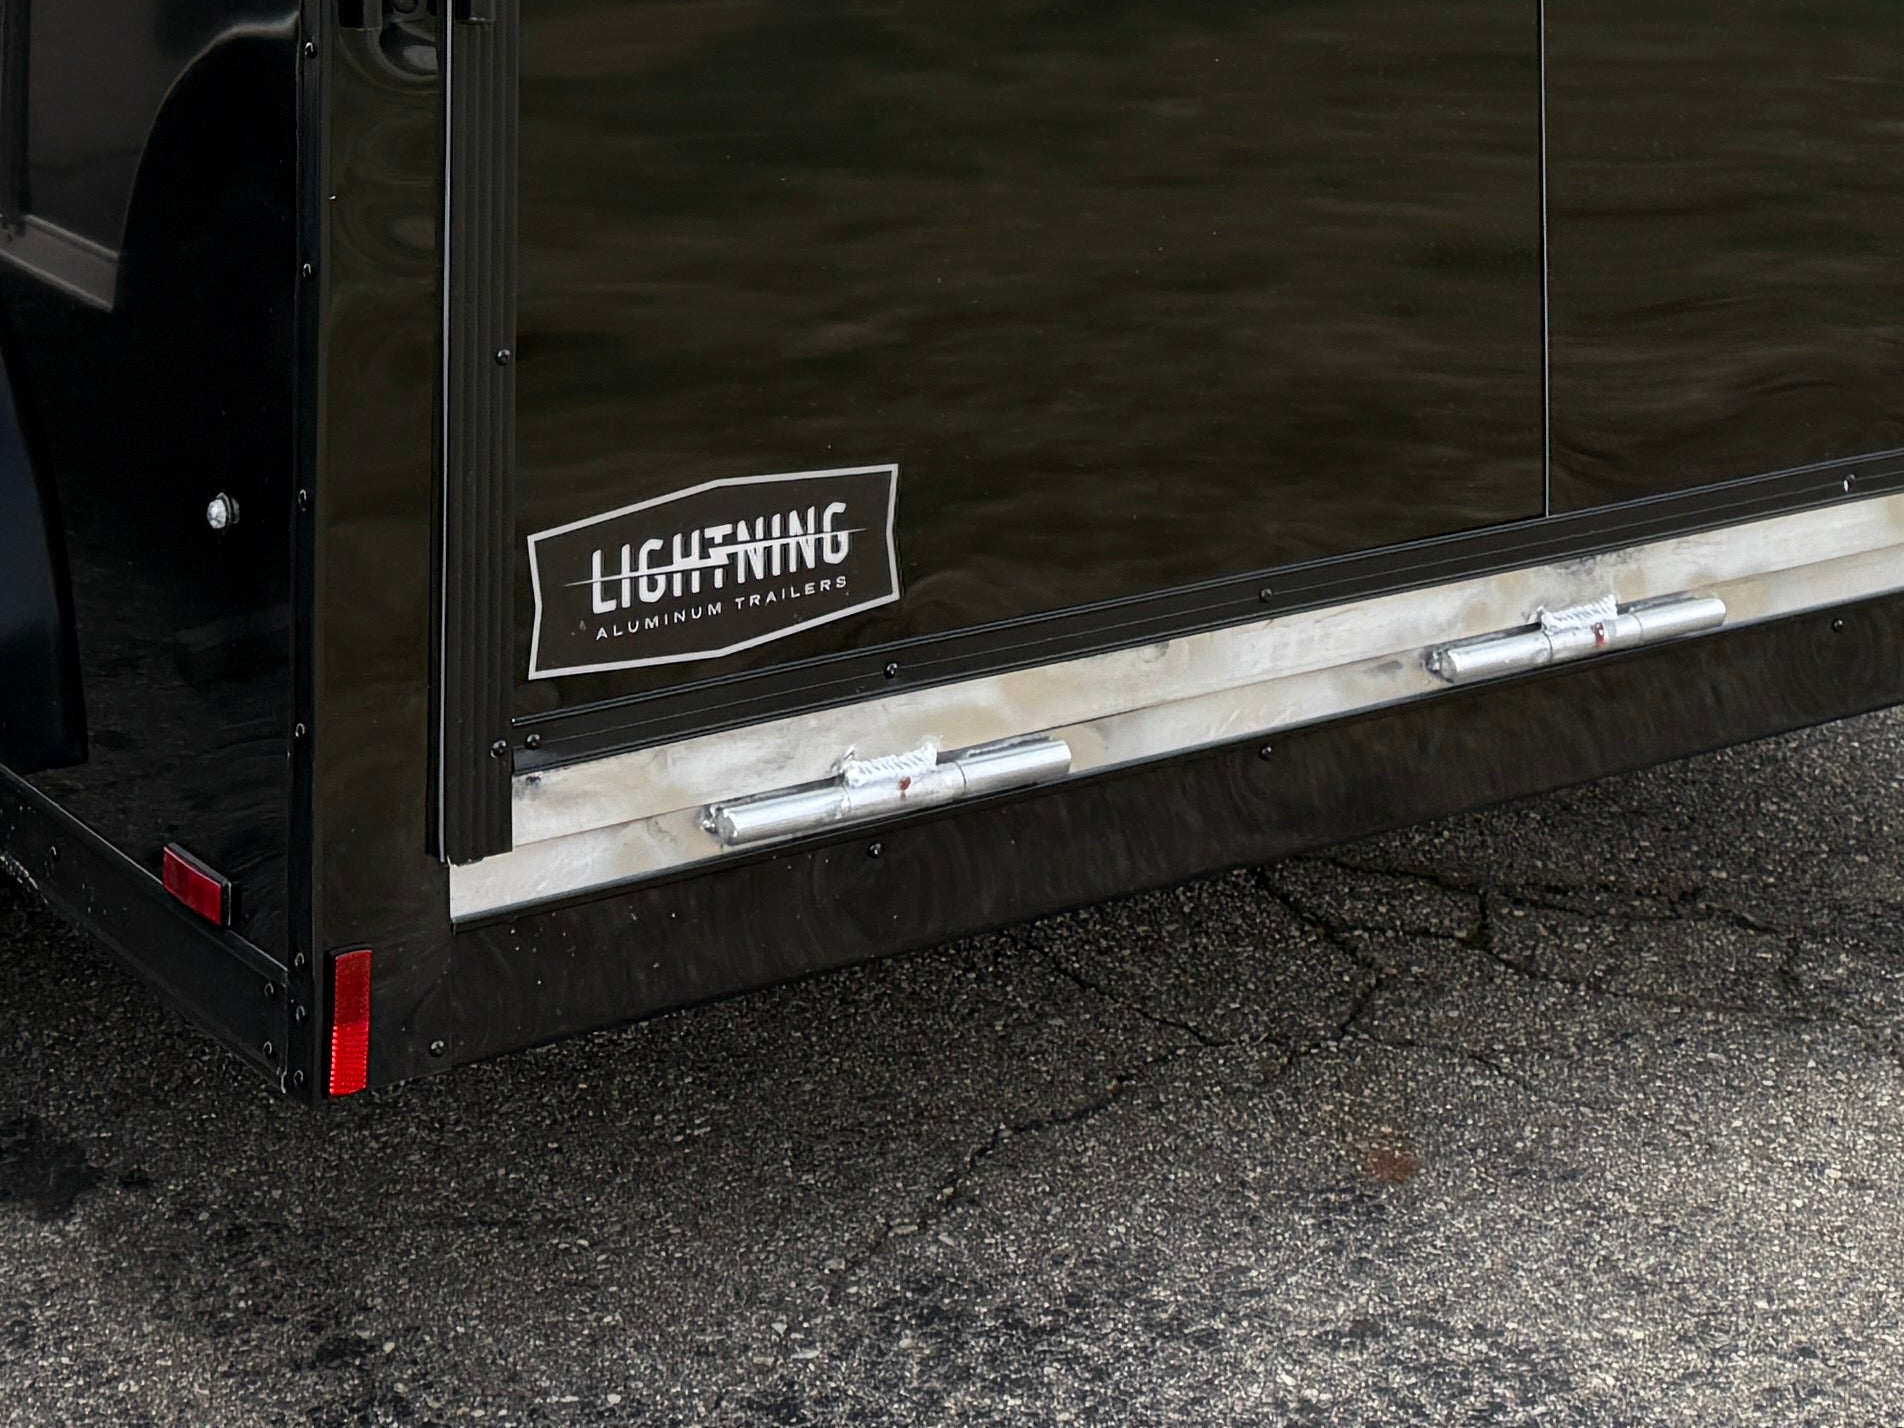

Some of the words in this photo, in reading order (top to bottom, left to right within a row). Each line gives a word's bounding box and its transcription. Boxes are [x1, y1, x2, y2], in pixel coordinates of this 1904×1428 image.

[591, 501, 850, 615] LIGHTNING
[596, 601, 723, 641] ALUMINUM
[735, 575, 848, 610] TRAILERS
